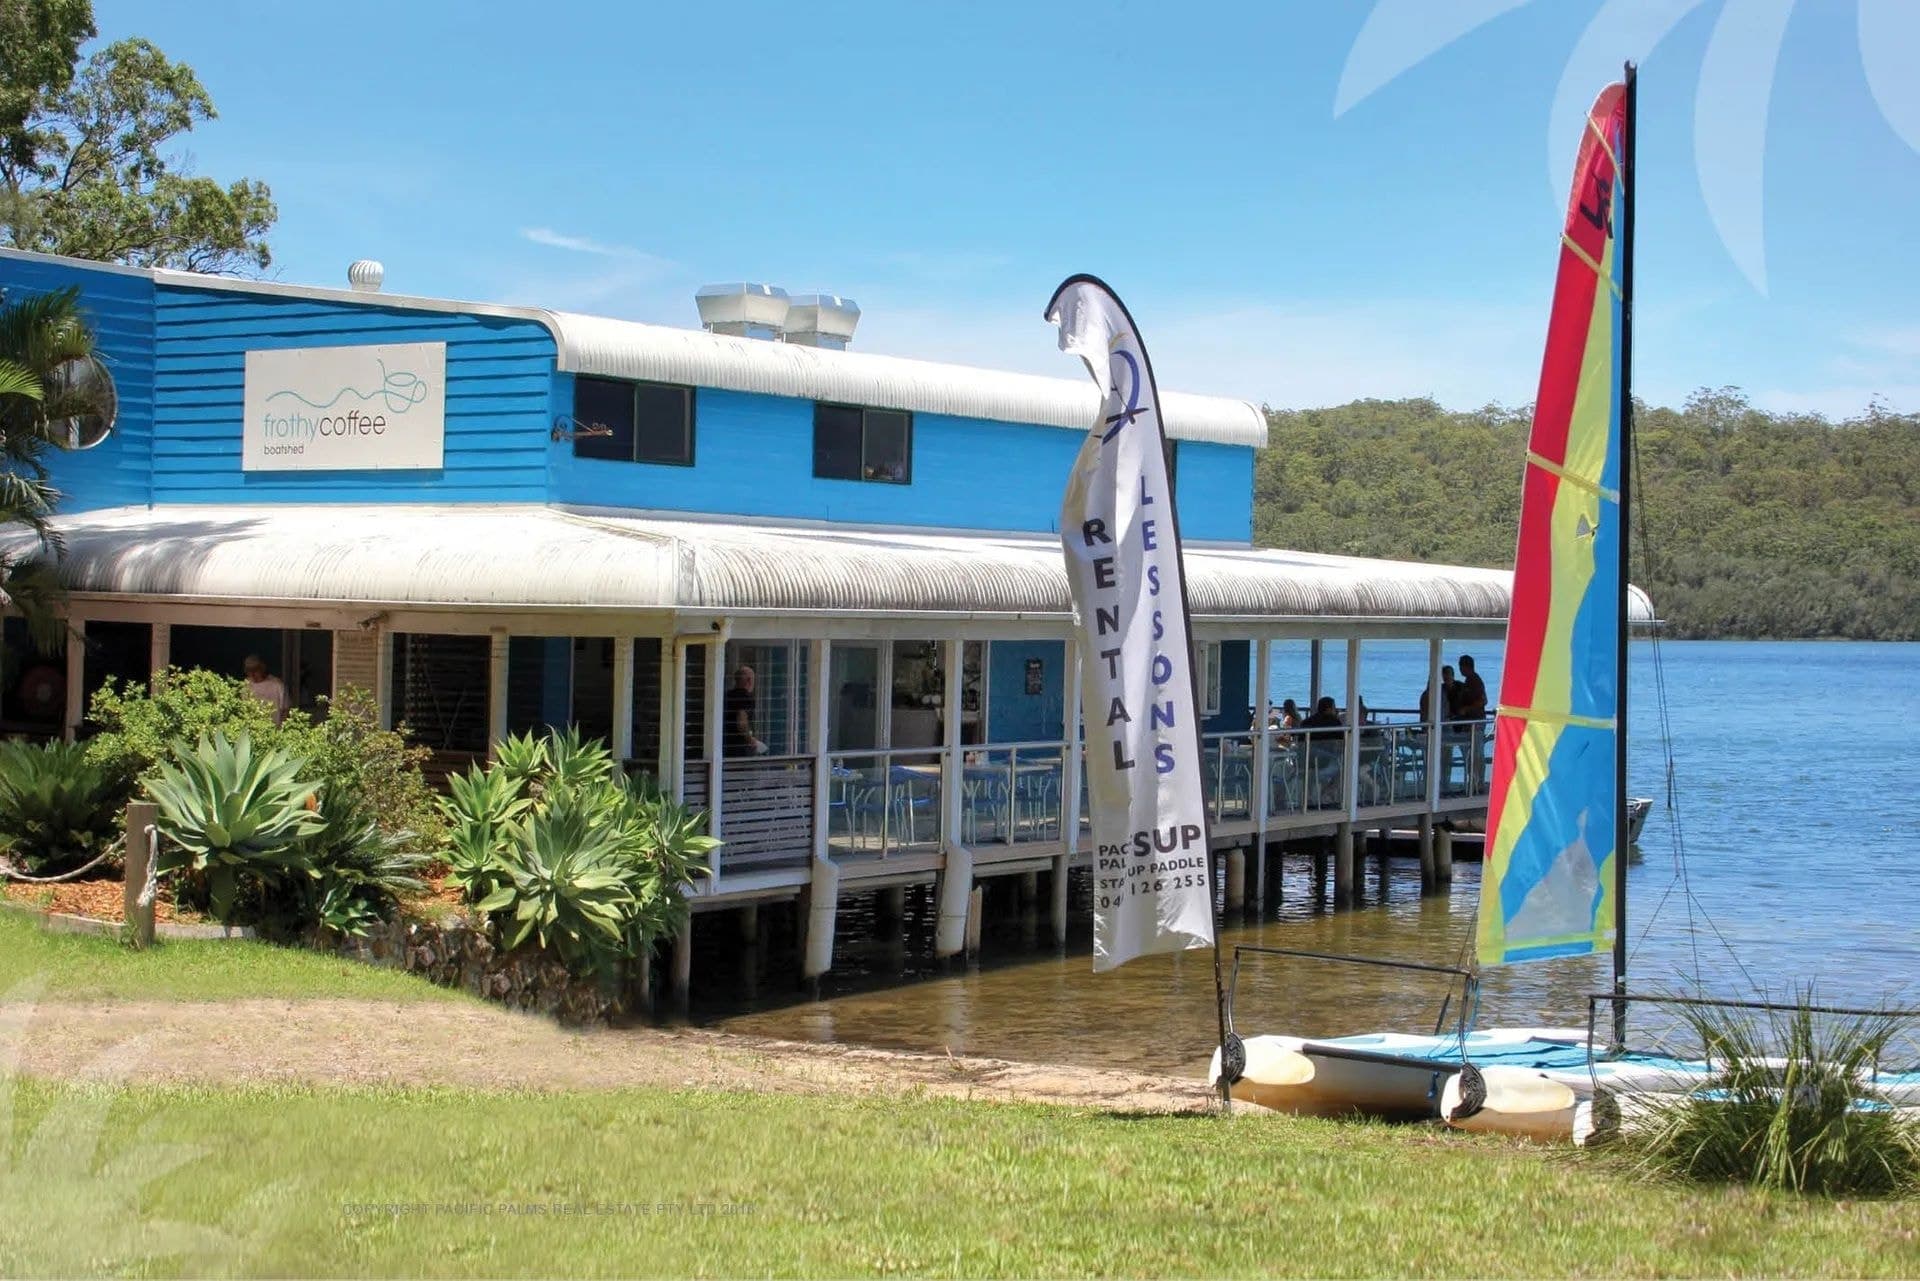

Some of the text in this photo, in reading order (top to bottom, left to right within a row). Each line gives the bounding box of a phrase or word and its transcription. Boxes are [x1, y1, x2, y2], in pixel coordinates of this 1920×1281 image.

[263, 444, 305, 455] boatshed
[1140, 475, 1176, 775] LESSONS
[1083, 518, 1135, 771] RENTAL
[1133, 824, 1201, 857] SUP
[1150, 857, 1205, 874] PADDLE
[1173, 874, 1206, 890] 255
